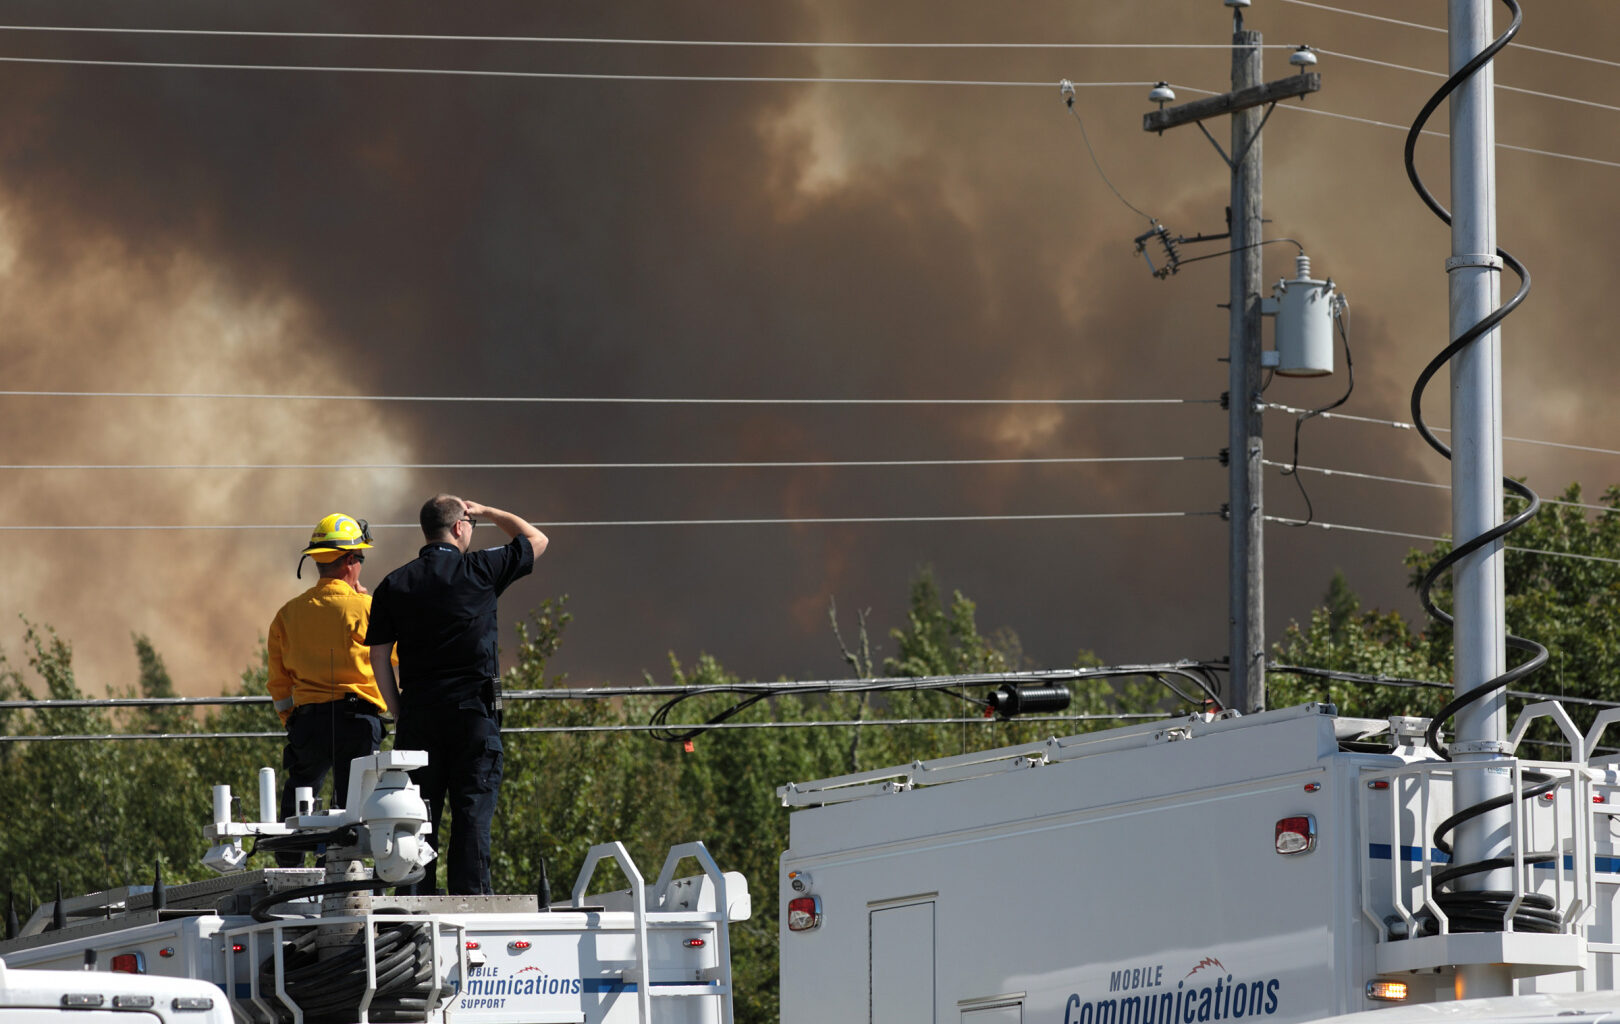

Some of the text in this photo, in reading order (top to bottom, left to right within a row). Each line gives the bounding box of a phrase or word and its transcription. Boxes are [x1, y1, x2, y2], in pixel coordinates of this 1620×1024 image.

[468, 967, 498, 977] OBILE
[1109, 964, 1163, 992] MOBILE
[460, 998, 506, 1009] SUPPORT
[1064, 974, 1280, 1024] Communications
